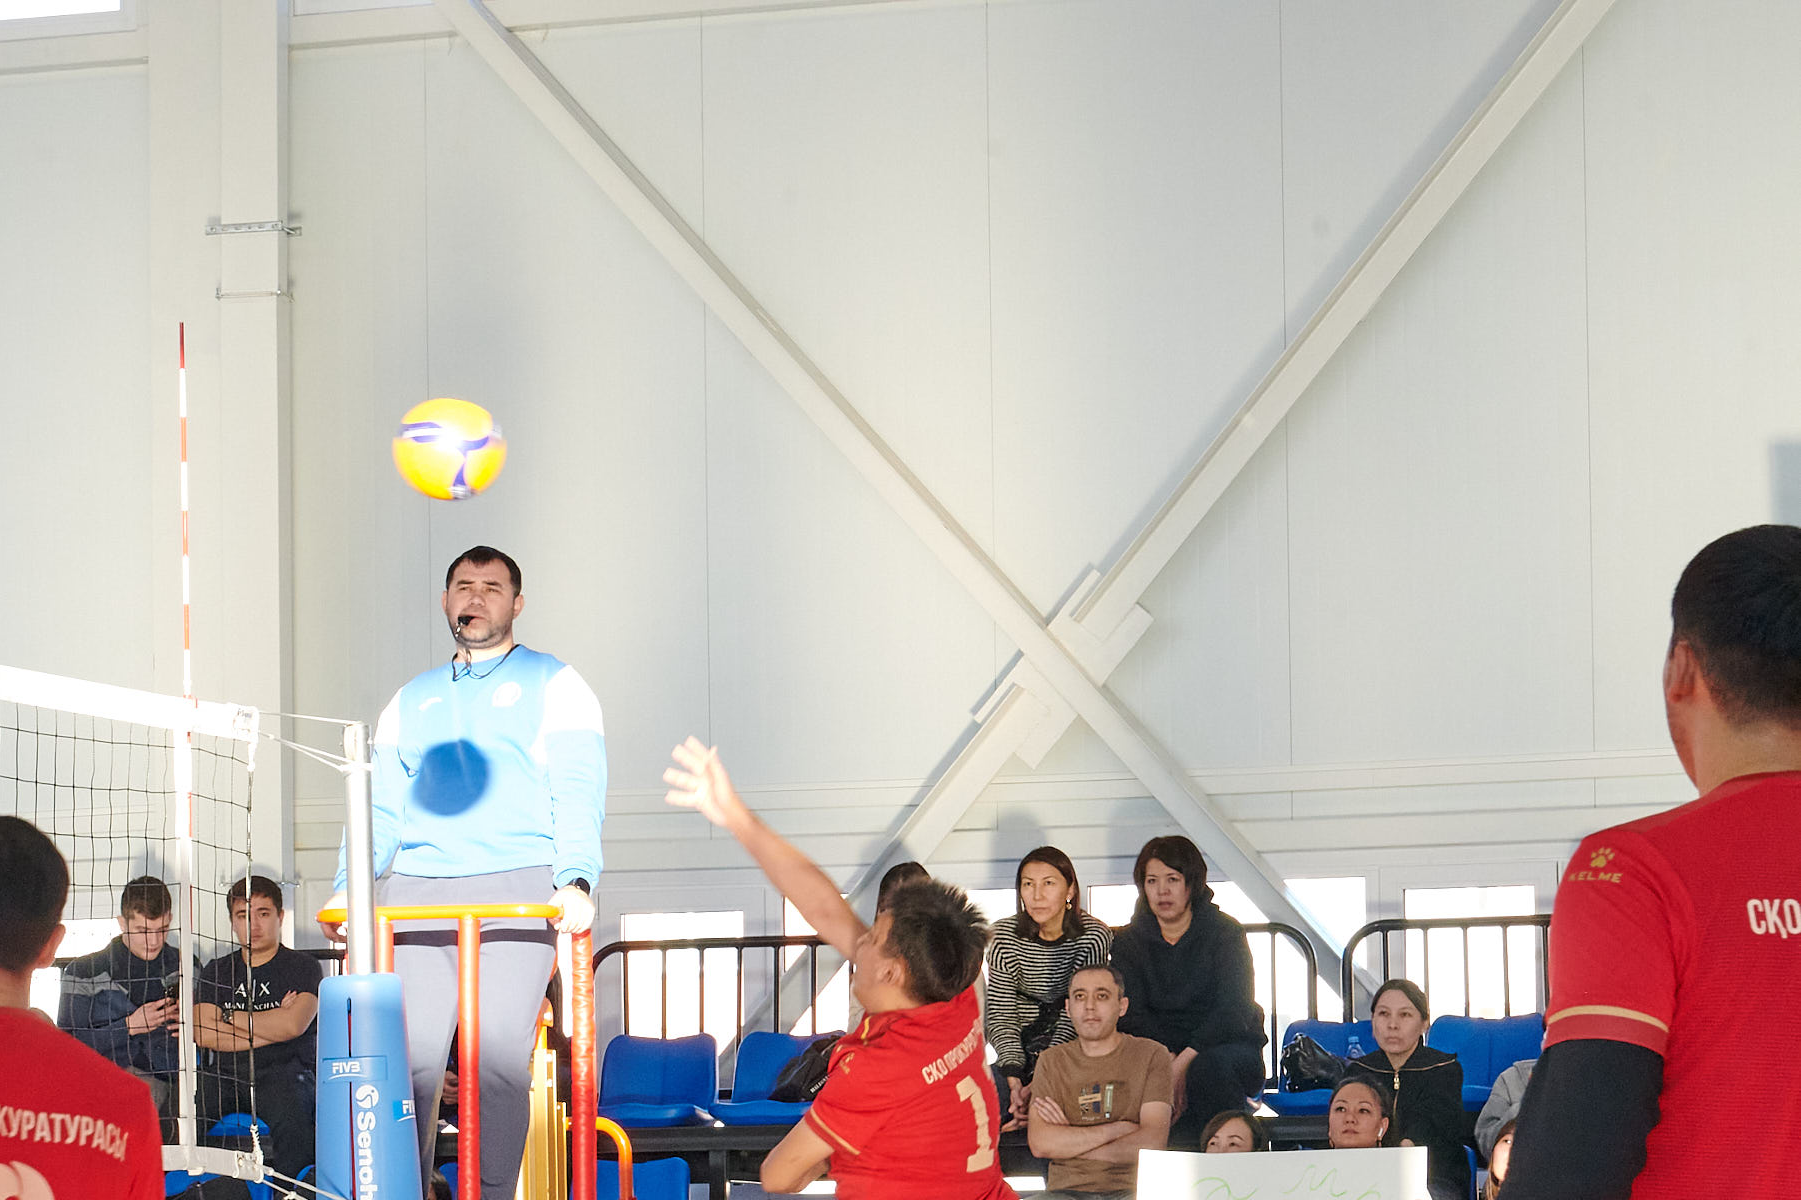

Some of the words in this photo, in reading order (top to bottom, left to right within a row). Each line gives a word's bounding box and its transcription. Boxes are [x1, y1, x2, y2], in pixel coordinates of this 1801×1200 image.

[1568, 871, 1623, 883] KELME
[332, 1061, 360, 1074] FIVB
[955, 1075, 994, 1173] 1
